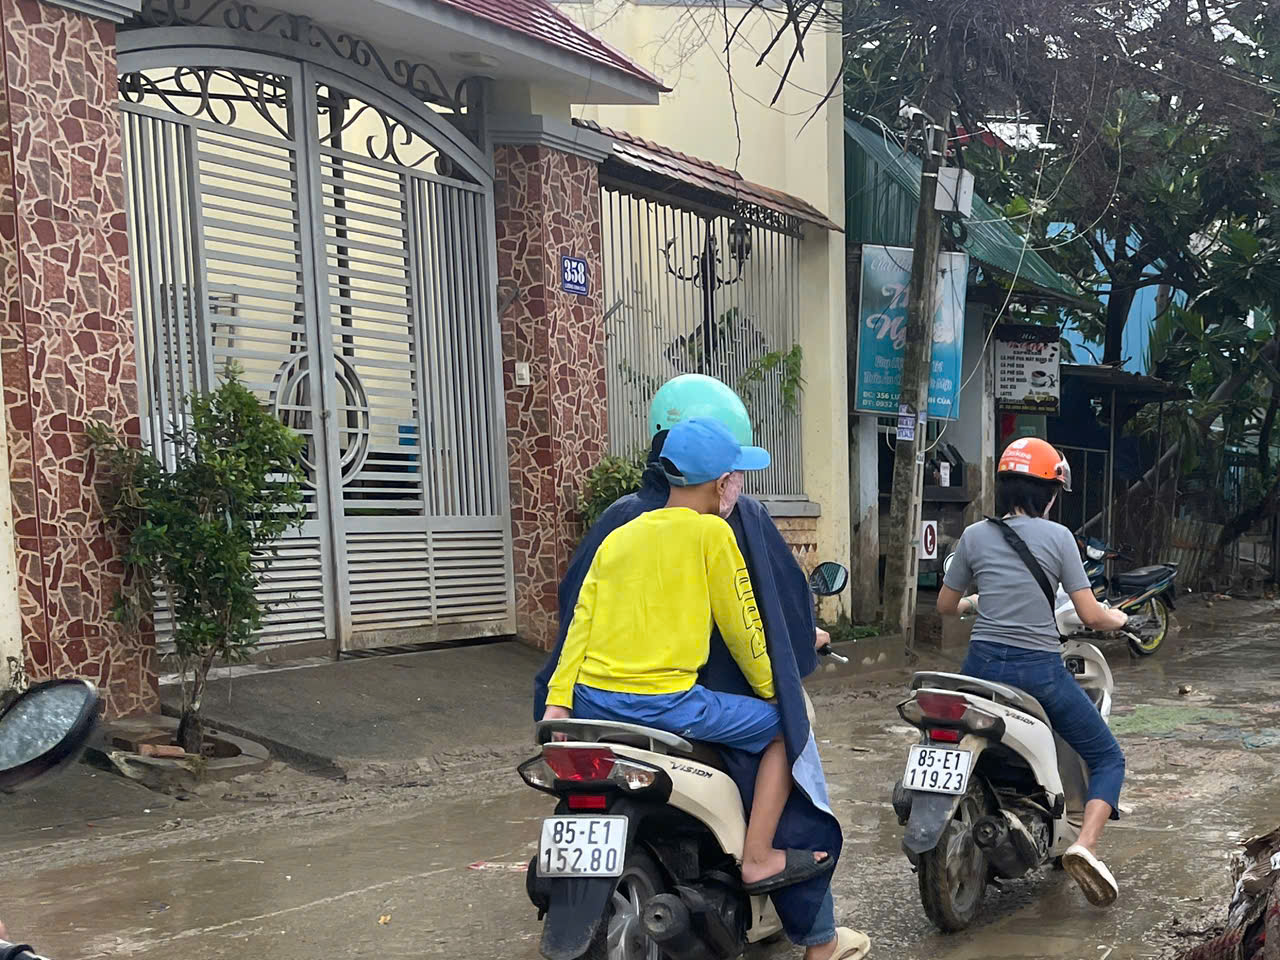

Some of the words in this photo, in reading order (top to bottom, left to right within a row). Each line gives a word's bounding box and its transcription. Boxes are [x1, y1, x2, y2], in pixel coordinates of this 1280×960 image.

[564, 259, 585, 284] 358
[670, 760, 713, 778] VISION
[918, 749, 961, 770] 85-E1
[910, 768, 964, 791] 119.23
[553, 820, 611, 844] 85-E1
[544, 847, 617, 872] 152.80
